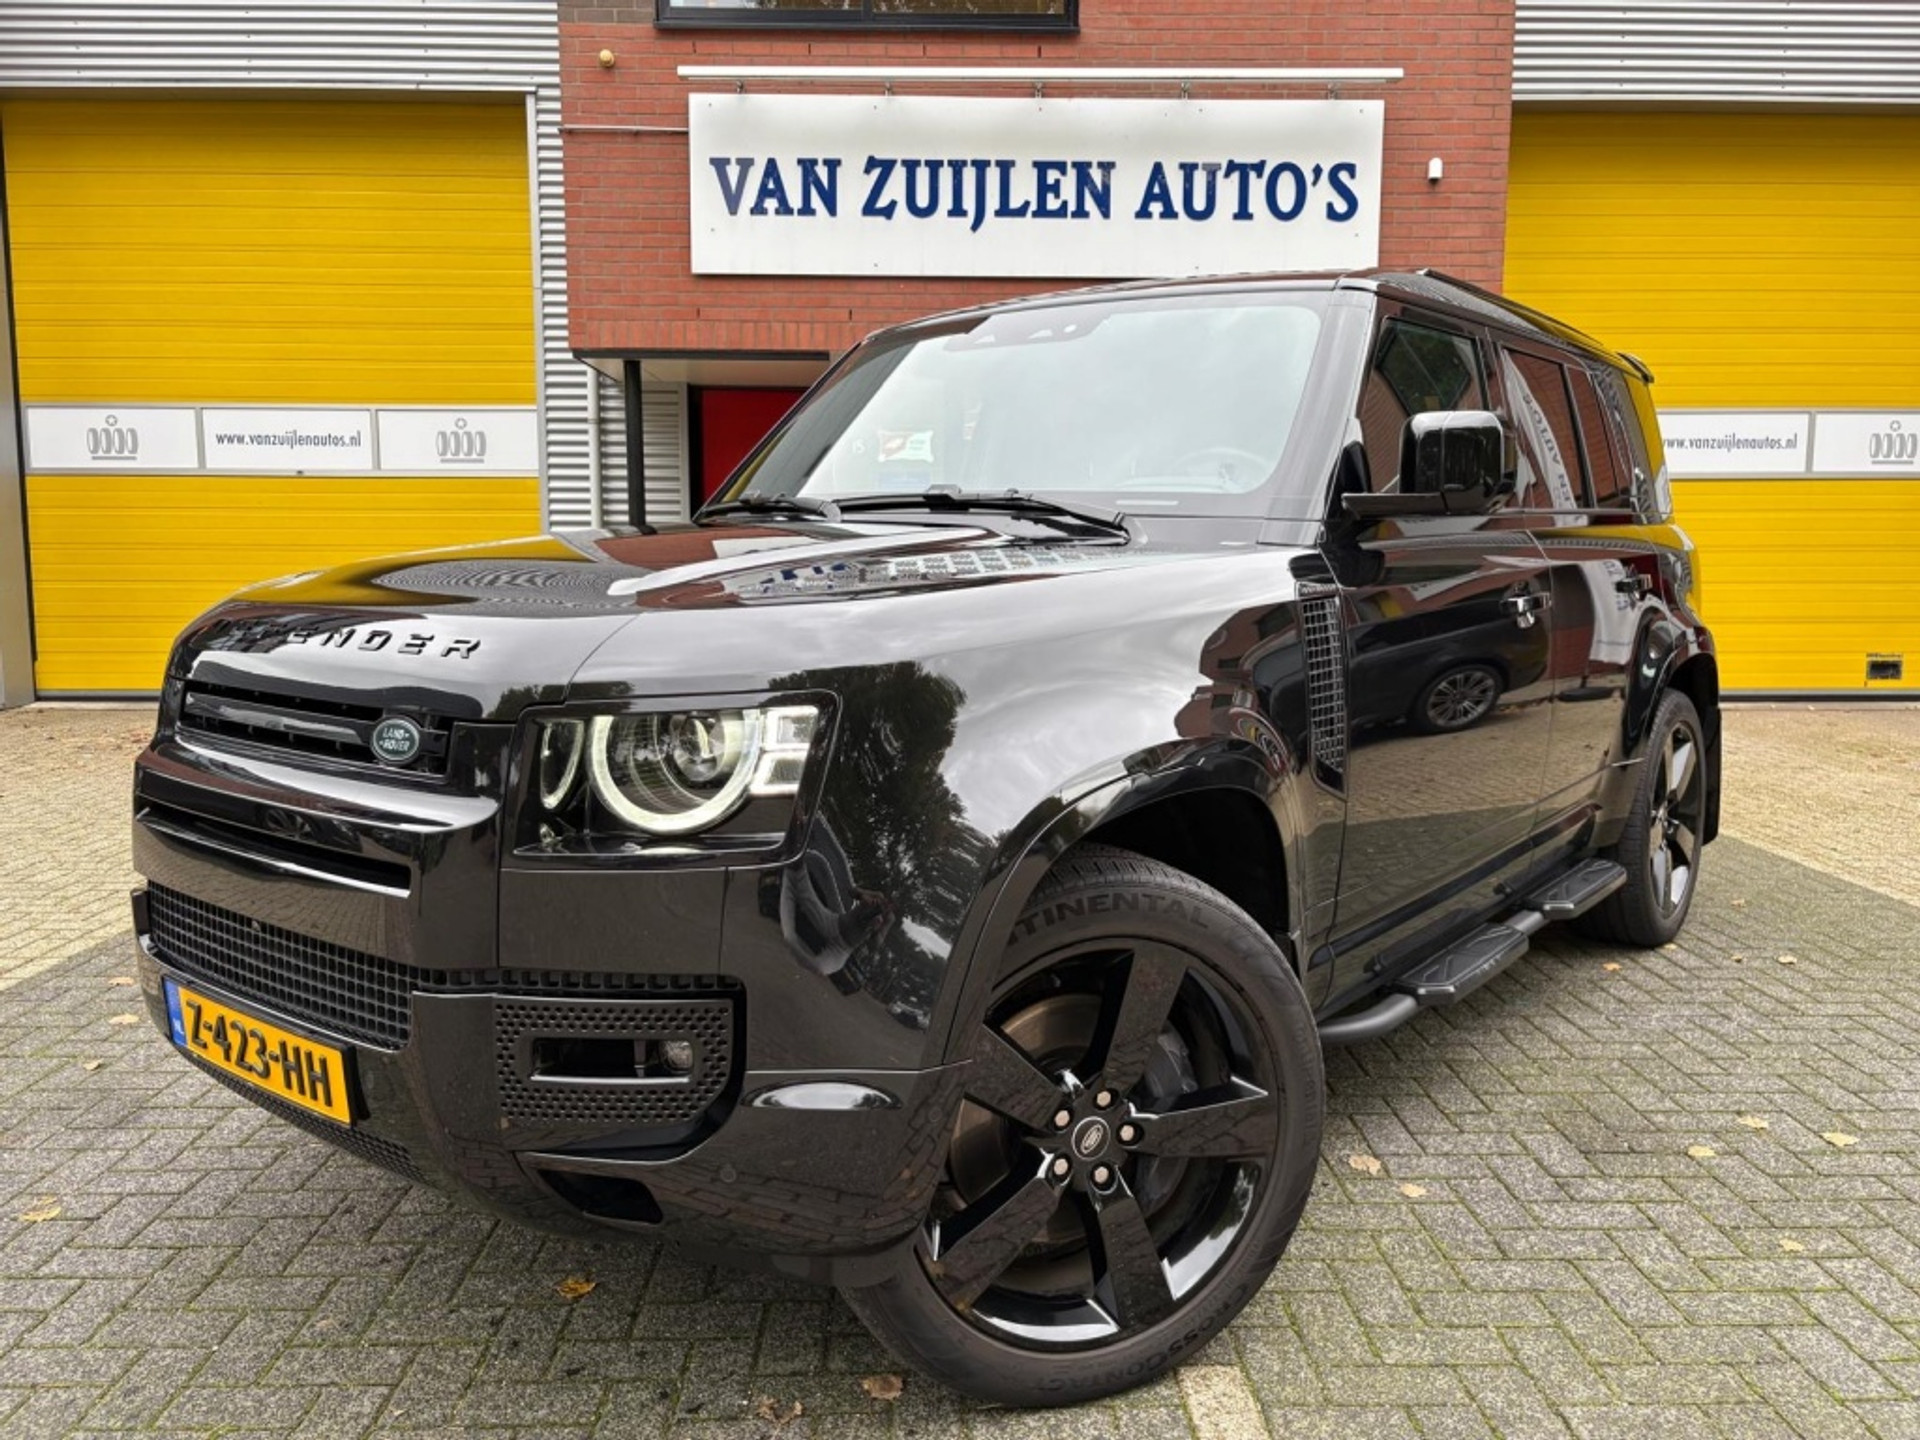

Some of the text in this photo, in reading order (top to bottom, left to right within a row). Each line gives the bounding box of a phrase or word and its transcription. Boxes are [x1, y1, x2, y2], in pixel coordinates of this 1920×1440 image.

[709, 154, 1359, 233] VAN ZUIJLEN AUTO'S
[215, 429, 362, 449] www.vanzuijlenautos.nl
[256, 623, 480, 659] ENDER
[1006, 891, 1209, 947] TINENTAL
[186, 1000, 333, 1108] Z-423-HH
